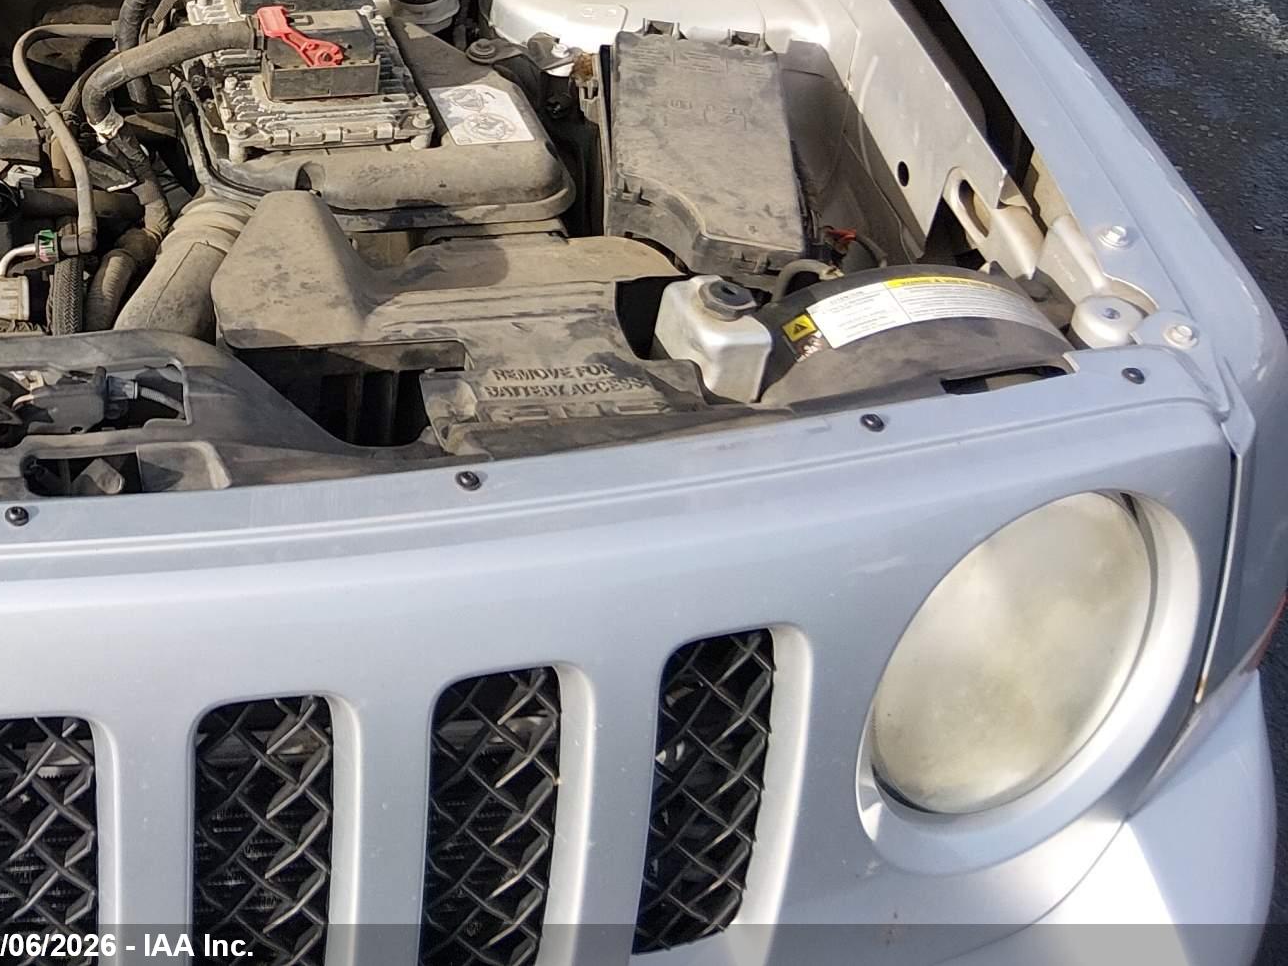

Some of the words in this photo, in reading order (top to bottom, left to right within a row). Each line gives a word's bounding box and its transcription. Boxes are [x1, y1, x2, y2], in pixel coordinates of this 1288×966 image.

[492, 367, 574, 382] REMOVE
[576, 363, 616, 378] FOR
[484, 384, 564, 398] BATTERY
[569, 377, 650, 396] ACCESS
